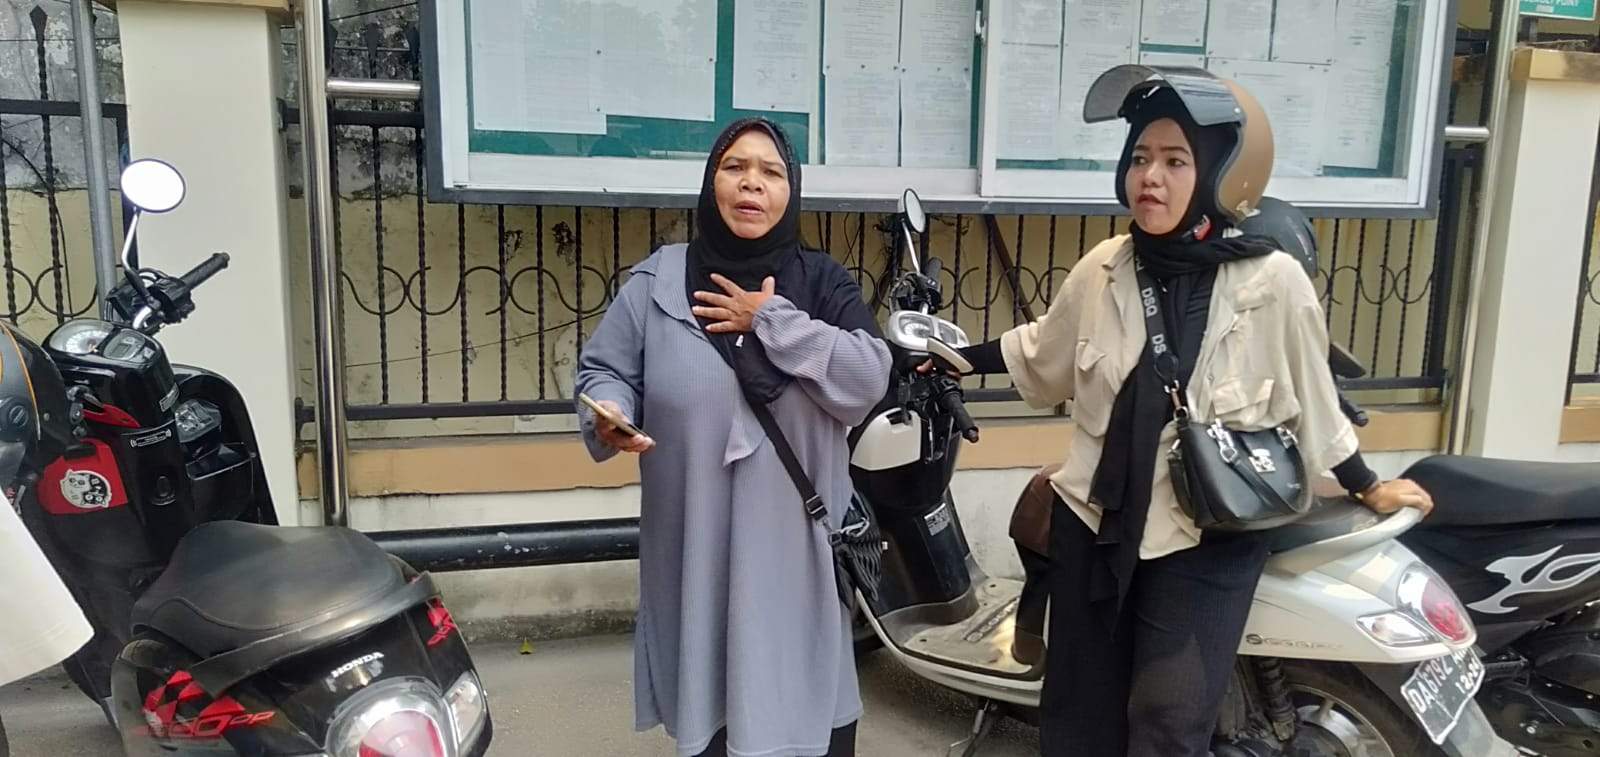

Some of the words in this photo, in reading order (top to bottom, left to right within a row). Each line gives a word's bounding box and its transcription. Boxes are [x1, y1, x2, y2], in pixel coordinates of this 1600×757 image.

[1141, 286, 1158, 318] DSQ
[1152, 333, 1167, 355] DS
[331, 651, 384, 678] HONDA
